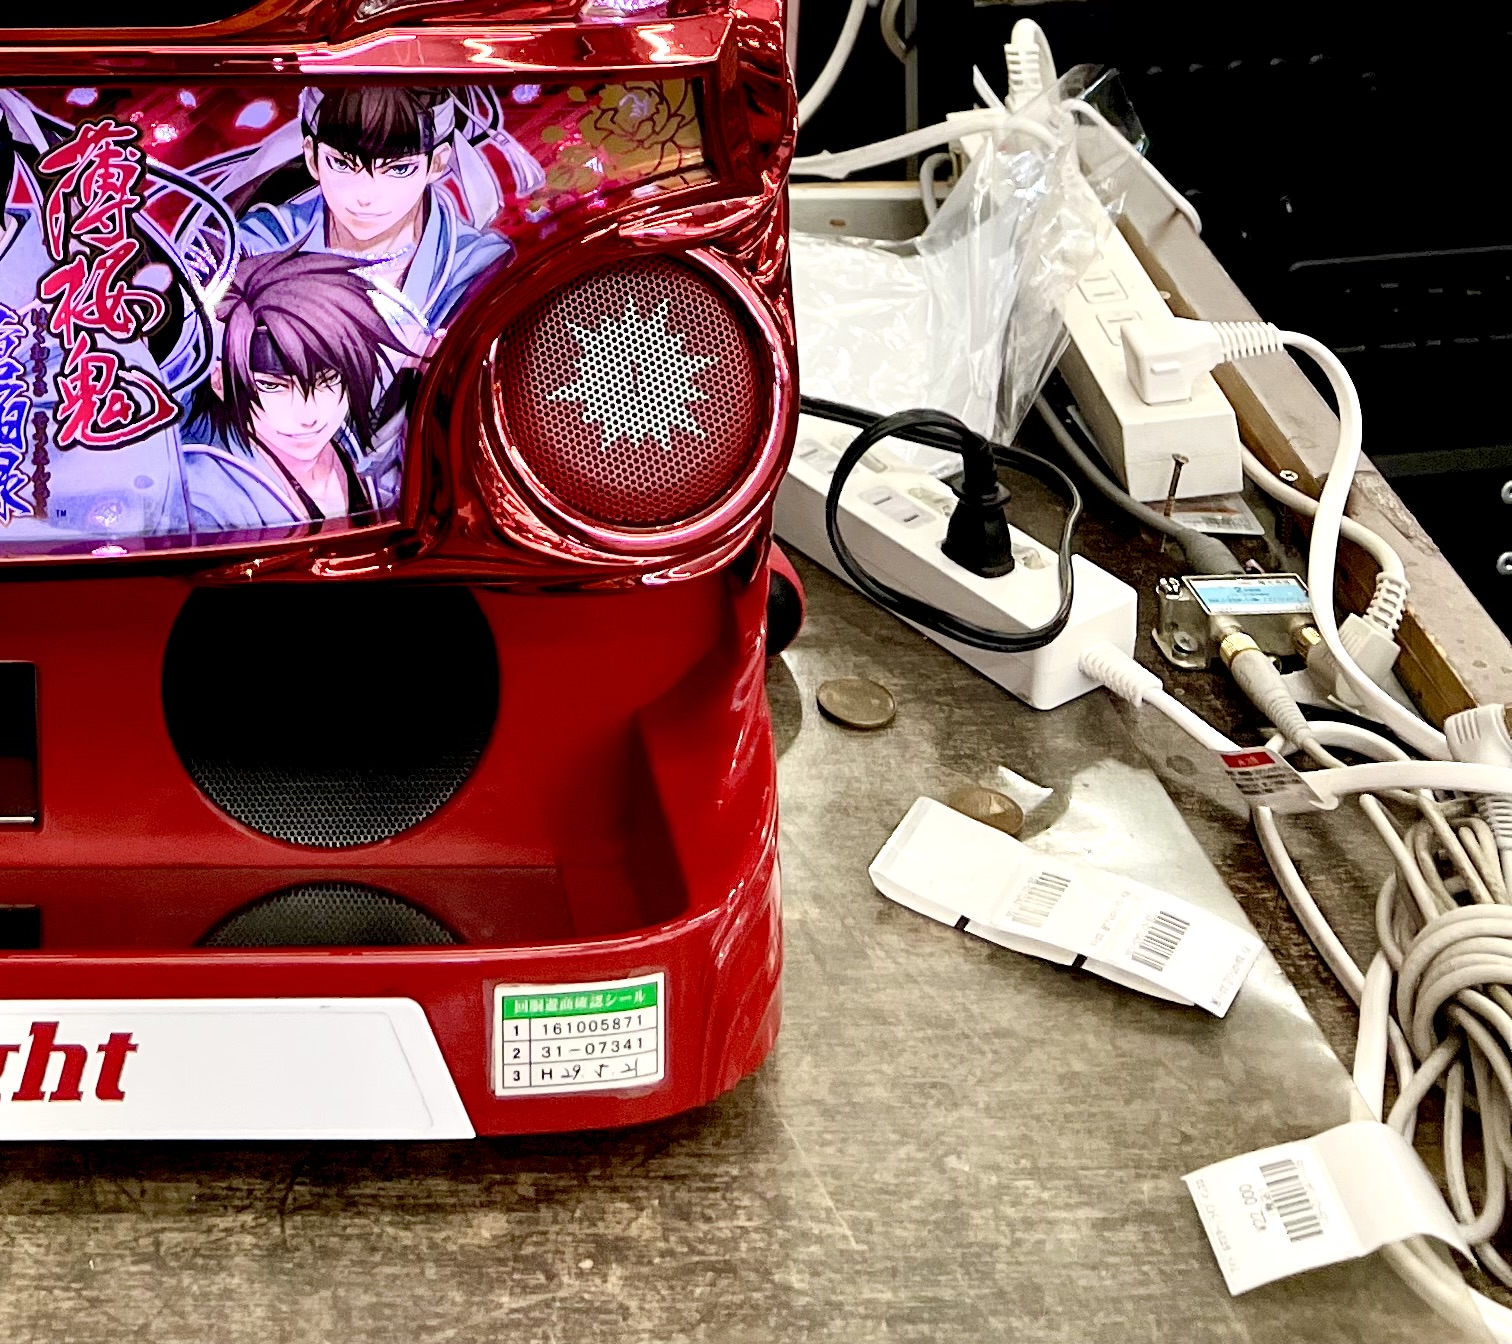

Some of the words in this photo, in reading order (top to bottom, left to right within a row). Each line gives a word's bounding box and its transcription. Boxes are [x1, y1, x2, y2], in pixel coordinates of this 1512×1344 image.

[38, 116, 178, 450] 薄桜鬼
[513, 1025, 519, 1036] 1
[542, 1014, 643, 1035] 161005871
[512, 1048, 521, 1059] 2
[541, 1037, 643, 1058] 31-07341
[512, 1070, 521, 1082] 3
